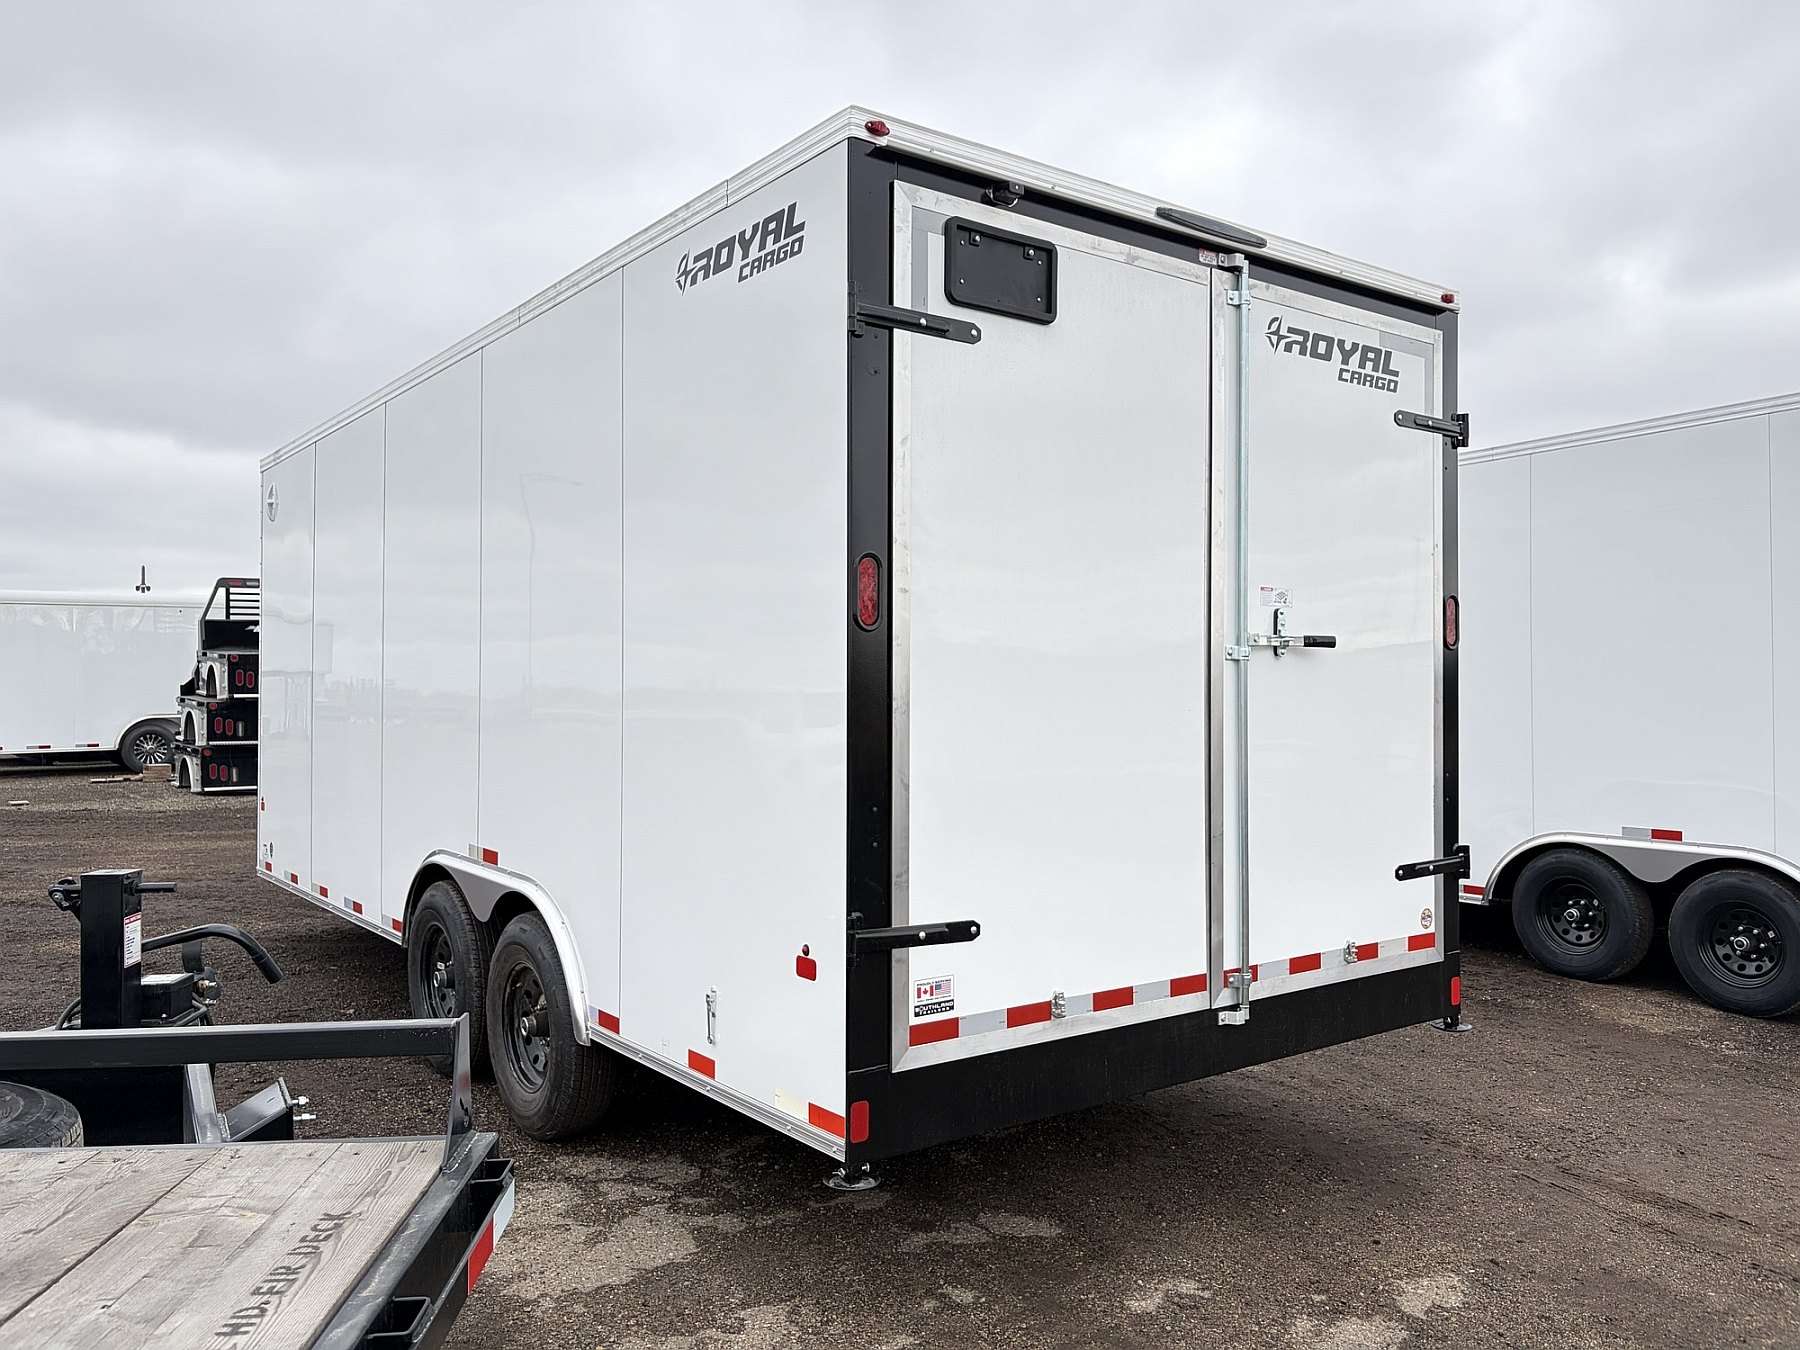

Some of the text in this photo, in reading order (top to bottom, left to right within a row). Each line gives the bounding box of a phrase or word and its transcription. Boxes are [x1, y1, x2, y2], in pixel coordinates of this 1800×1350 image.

[689, 201, 806, 287] ROYAL
[737, 234, 805, 283] CARGO
[1283, 326, 1400, 378] ROYAL
[1337, 367, 1399, 393] CARGO
[915, 1001, 954, 1013] SOUTHLAND
[286, 1210, 353, 1256] DECK
